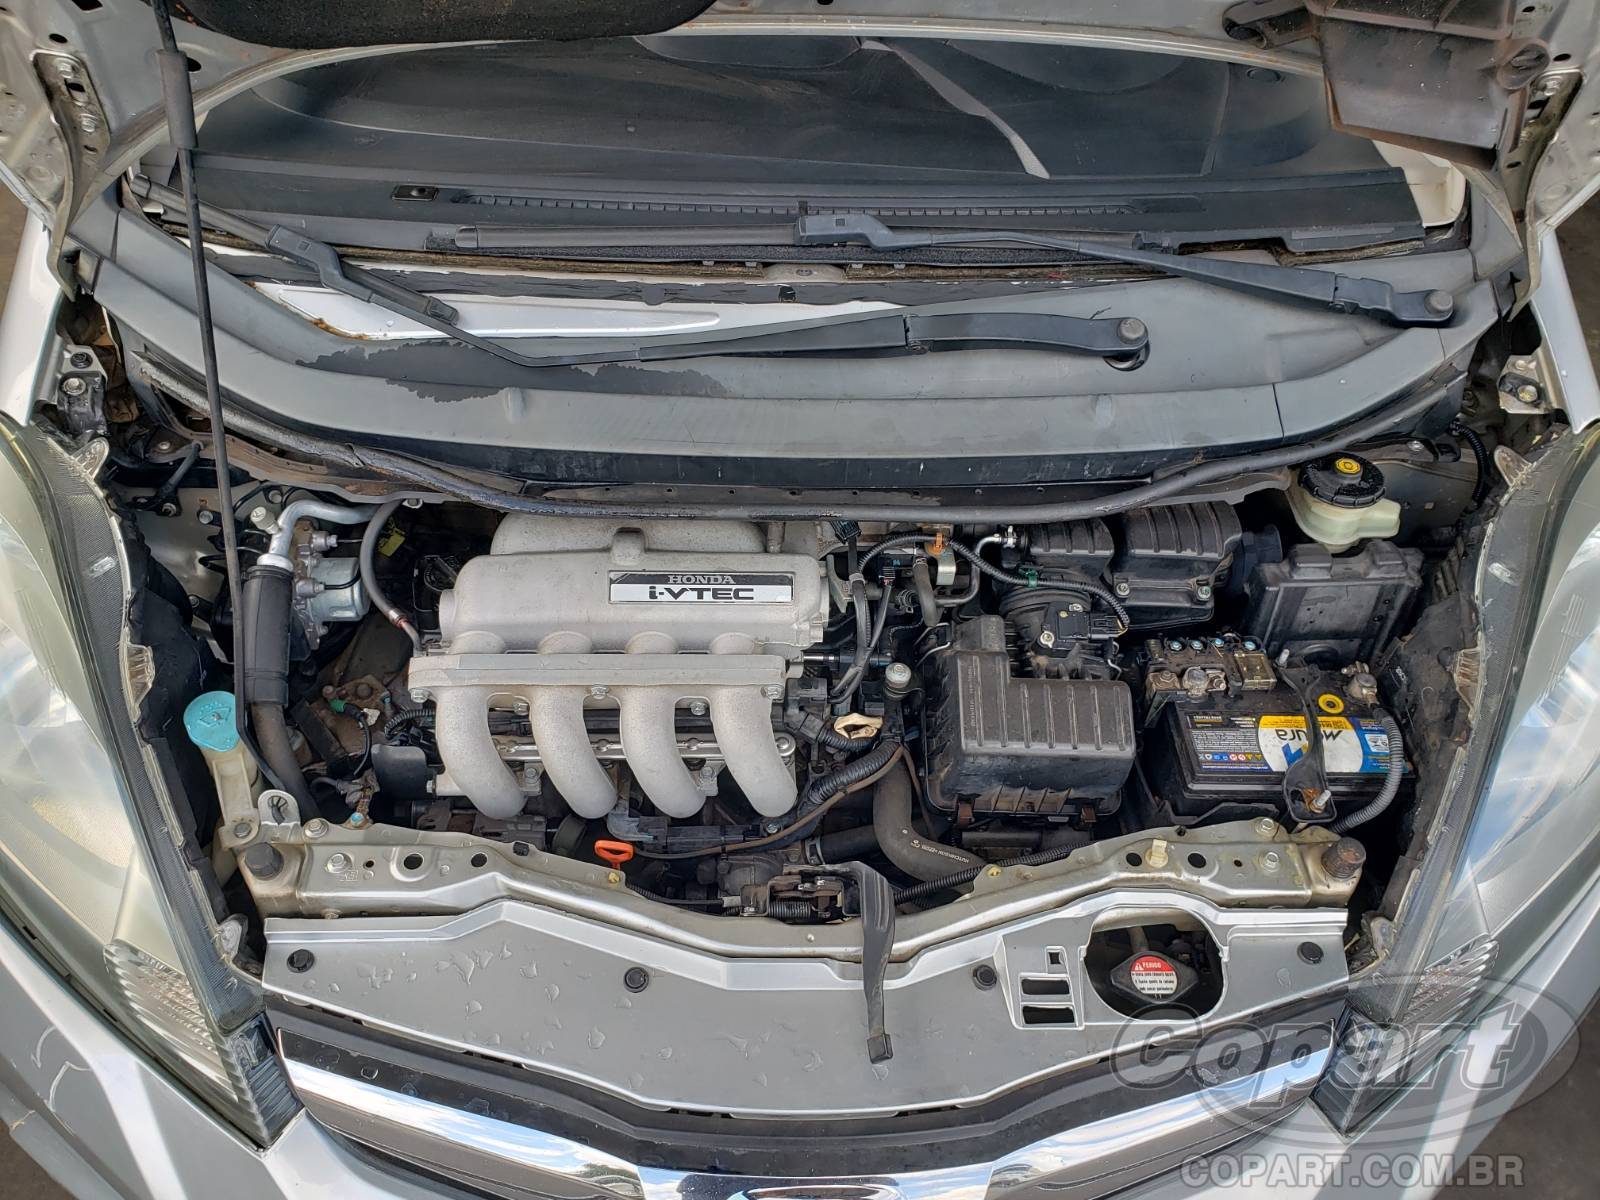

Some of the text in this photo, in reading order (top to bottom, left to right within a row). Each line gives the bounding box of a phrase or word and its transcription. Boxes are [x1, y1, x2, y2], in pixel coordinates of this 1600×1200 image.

[668, 575, 736, 584] HONDA
[649, 586, 754, 600] i-VTEC
[1276, 729, 1343, 742] Mura
